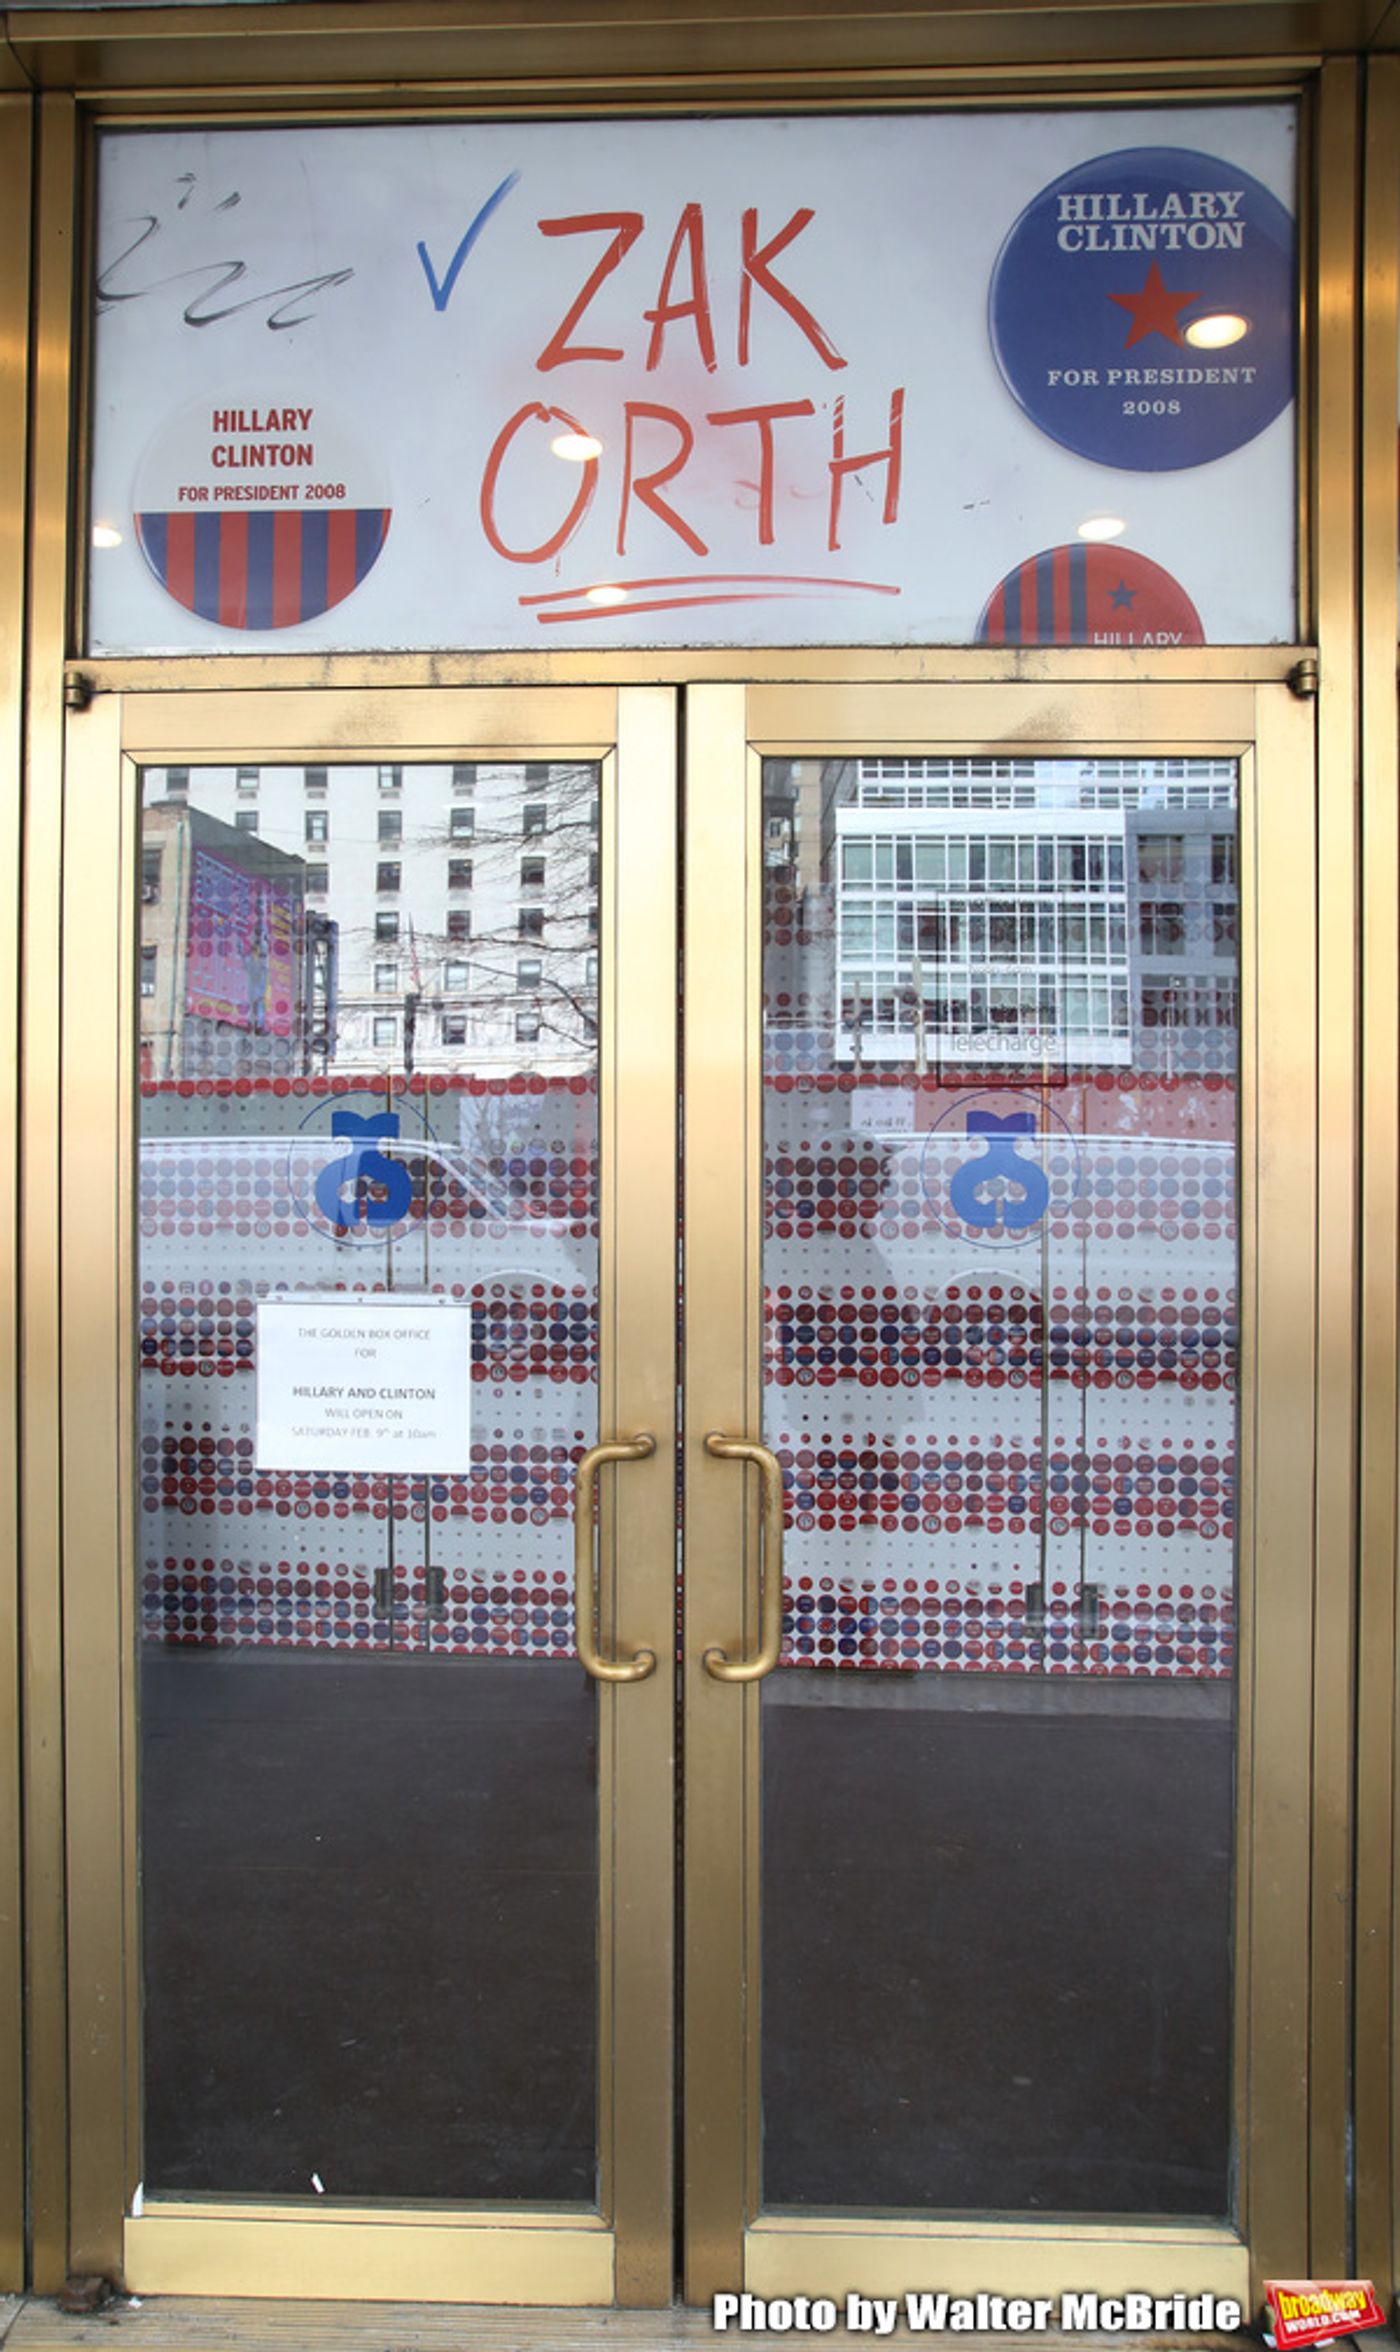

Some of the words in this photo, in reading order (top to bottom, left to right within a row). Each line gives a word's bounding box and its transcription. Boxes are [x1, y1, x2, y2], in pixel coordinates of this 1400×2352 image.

[1057, 191, 1244, 222] HILLARY
[1057, 222, 1244, 253] CLINTON
[536, 203, 848, 374] ZAK
[1047, 369, 1099, 386] FOR
[1107, 367, 1257, 386] PRESIDENT
[1122, 401, 1182, 415] 2008
[212, 408, 314, 433] HILLARY
[211, 445, 314, 468] CLINTON
[480, 388, 906, 564] ORTH
[178, 485, 209, 502] FOR
[214, 485, 300, 502] PRESIDENT
[305, 484, 346, 501] 2008
[298, 1328, 317, 1339] THE
[320, 1328, 366, 1340] GOLDEN
[369, 1329, 391, 1340] BOX
[394, 1329, 431, 1341] OFFICE
[354, 1348, 377, 1359] FOR
[292, 1386, 344, 1399] HILLARY
[347, 1387, 377, 1399] AND
[379, 1388, 436, 1400] CLINTON
[324, 1409, 350, 1419] WILL
[353, 1409, 384, 1420] OPEN
[385, 1410, 403, 1420] ON
[291, 1427, 348, 1438] SATURDAY
